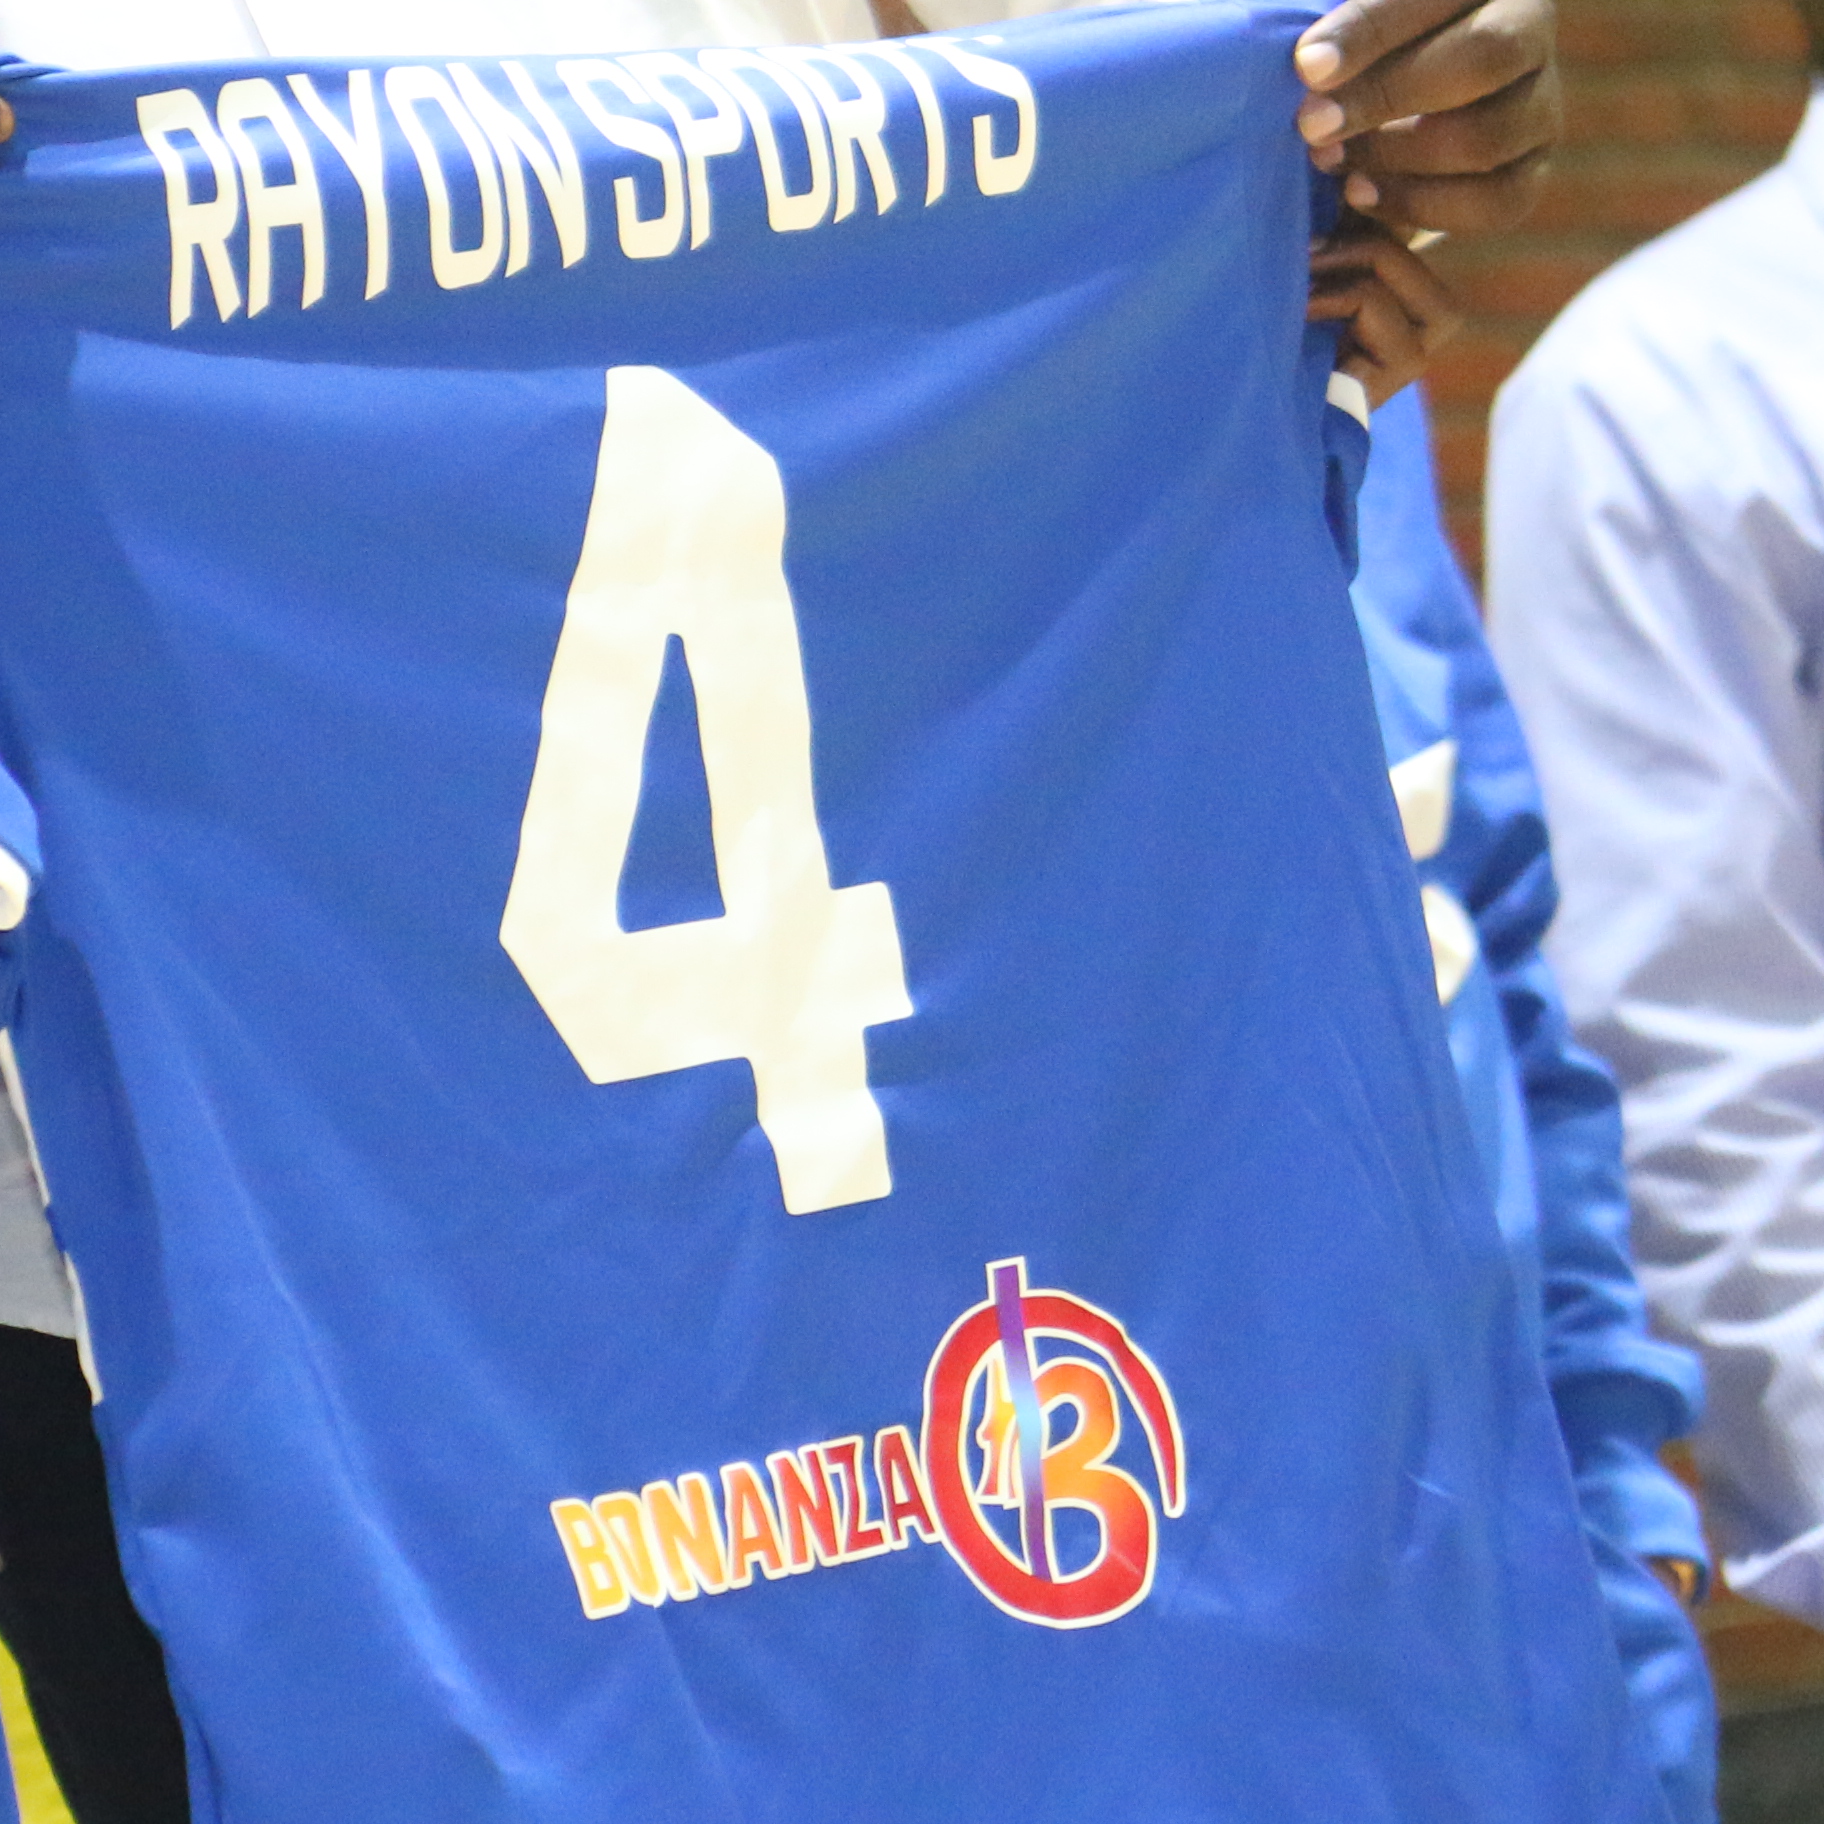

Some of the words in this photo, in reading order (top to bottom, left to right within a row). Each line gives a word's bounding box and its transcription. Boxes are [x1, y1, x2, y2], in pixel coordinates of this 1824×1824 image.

[138, 65, 585, 330] RAYON
[558, 35, 1040, 260] SPORTS
[499, 365, 913, 1215] 4
[551, 1425, 942, 1619] BONANZA
